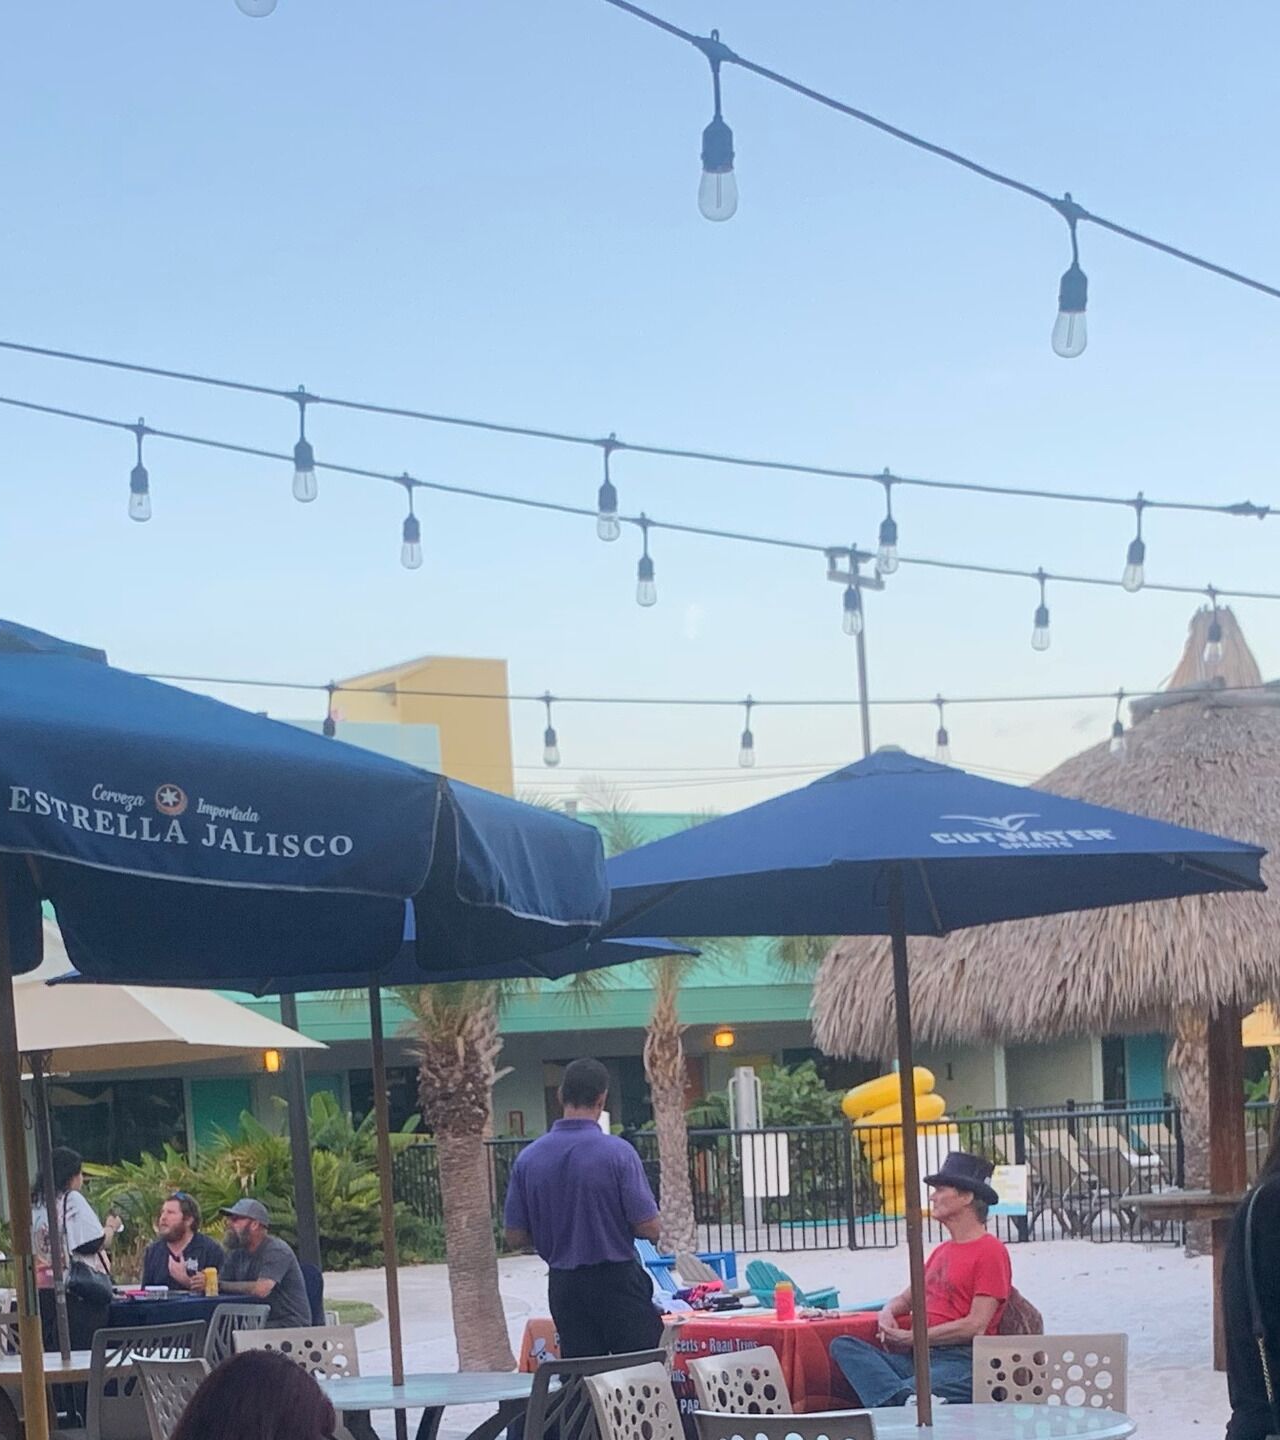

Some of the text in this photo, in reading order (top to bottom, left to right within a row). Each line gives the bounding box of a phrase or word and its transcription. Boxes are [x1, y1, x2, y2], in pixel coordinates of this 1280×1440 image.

[92, 783, 261, 823] Cerveza Importada
[8, 785, 354, 858] ESTRELLA JALISCO
[930, 828, 1117, 845] CUTWATER
[998, 841, 1074, 850] SPIRITS
[709, 1338, 733, 1353] Road
